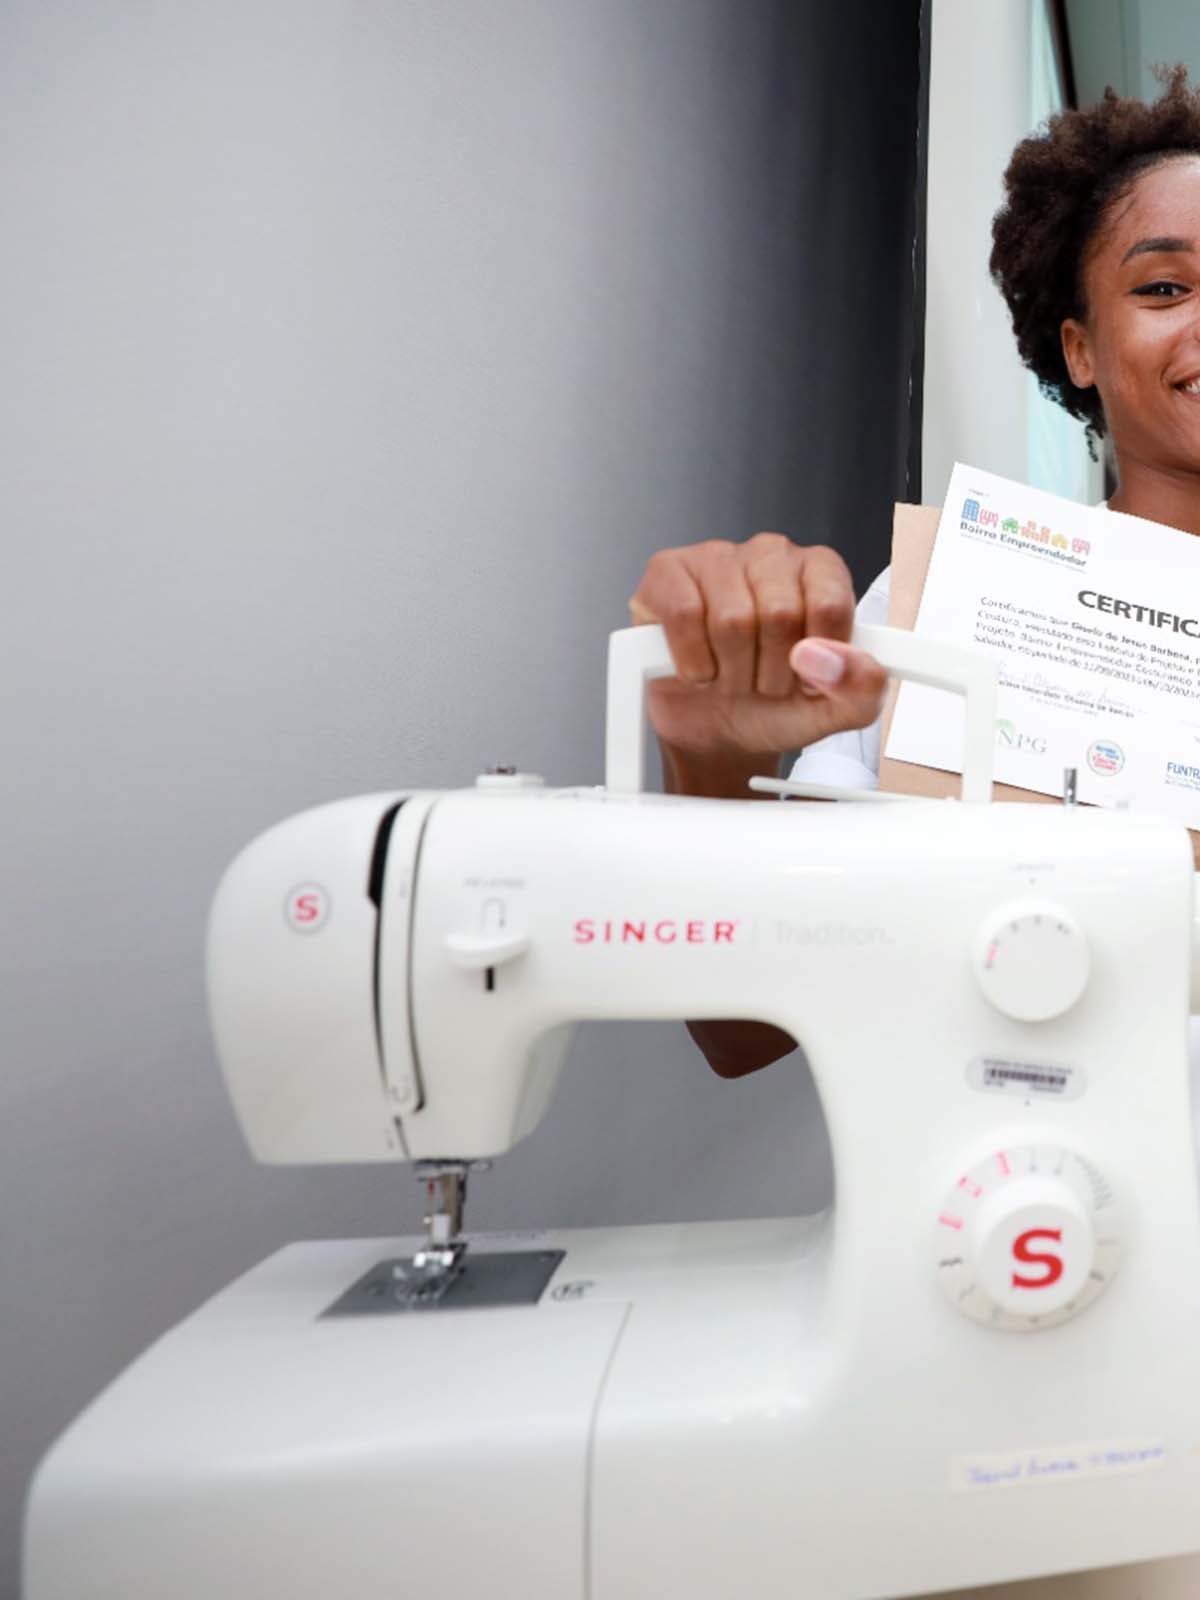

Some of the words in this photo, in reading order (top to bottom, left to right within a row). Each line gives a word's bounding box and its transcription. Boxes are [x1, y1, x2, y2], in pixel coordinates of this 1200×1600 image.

[960, 522, 996, 538] Bairro
[1000, 729, 1047, 753] NPG
[296, 894, 319, 922] S
[575, 919, 738, 944] SINGER
[1011, 1228, 1064, 1290] S
